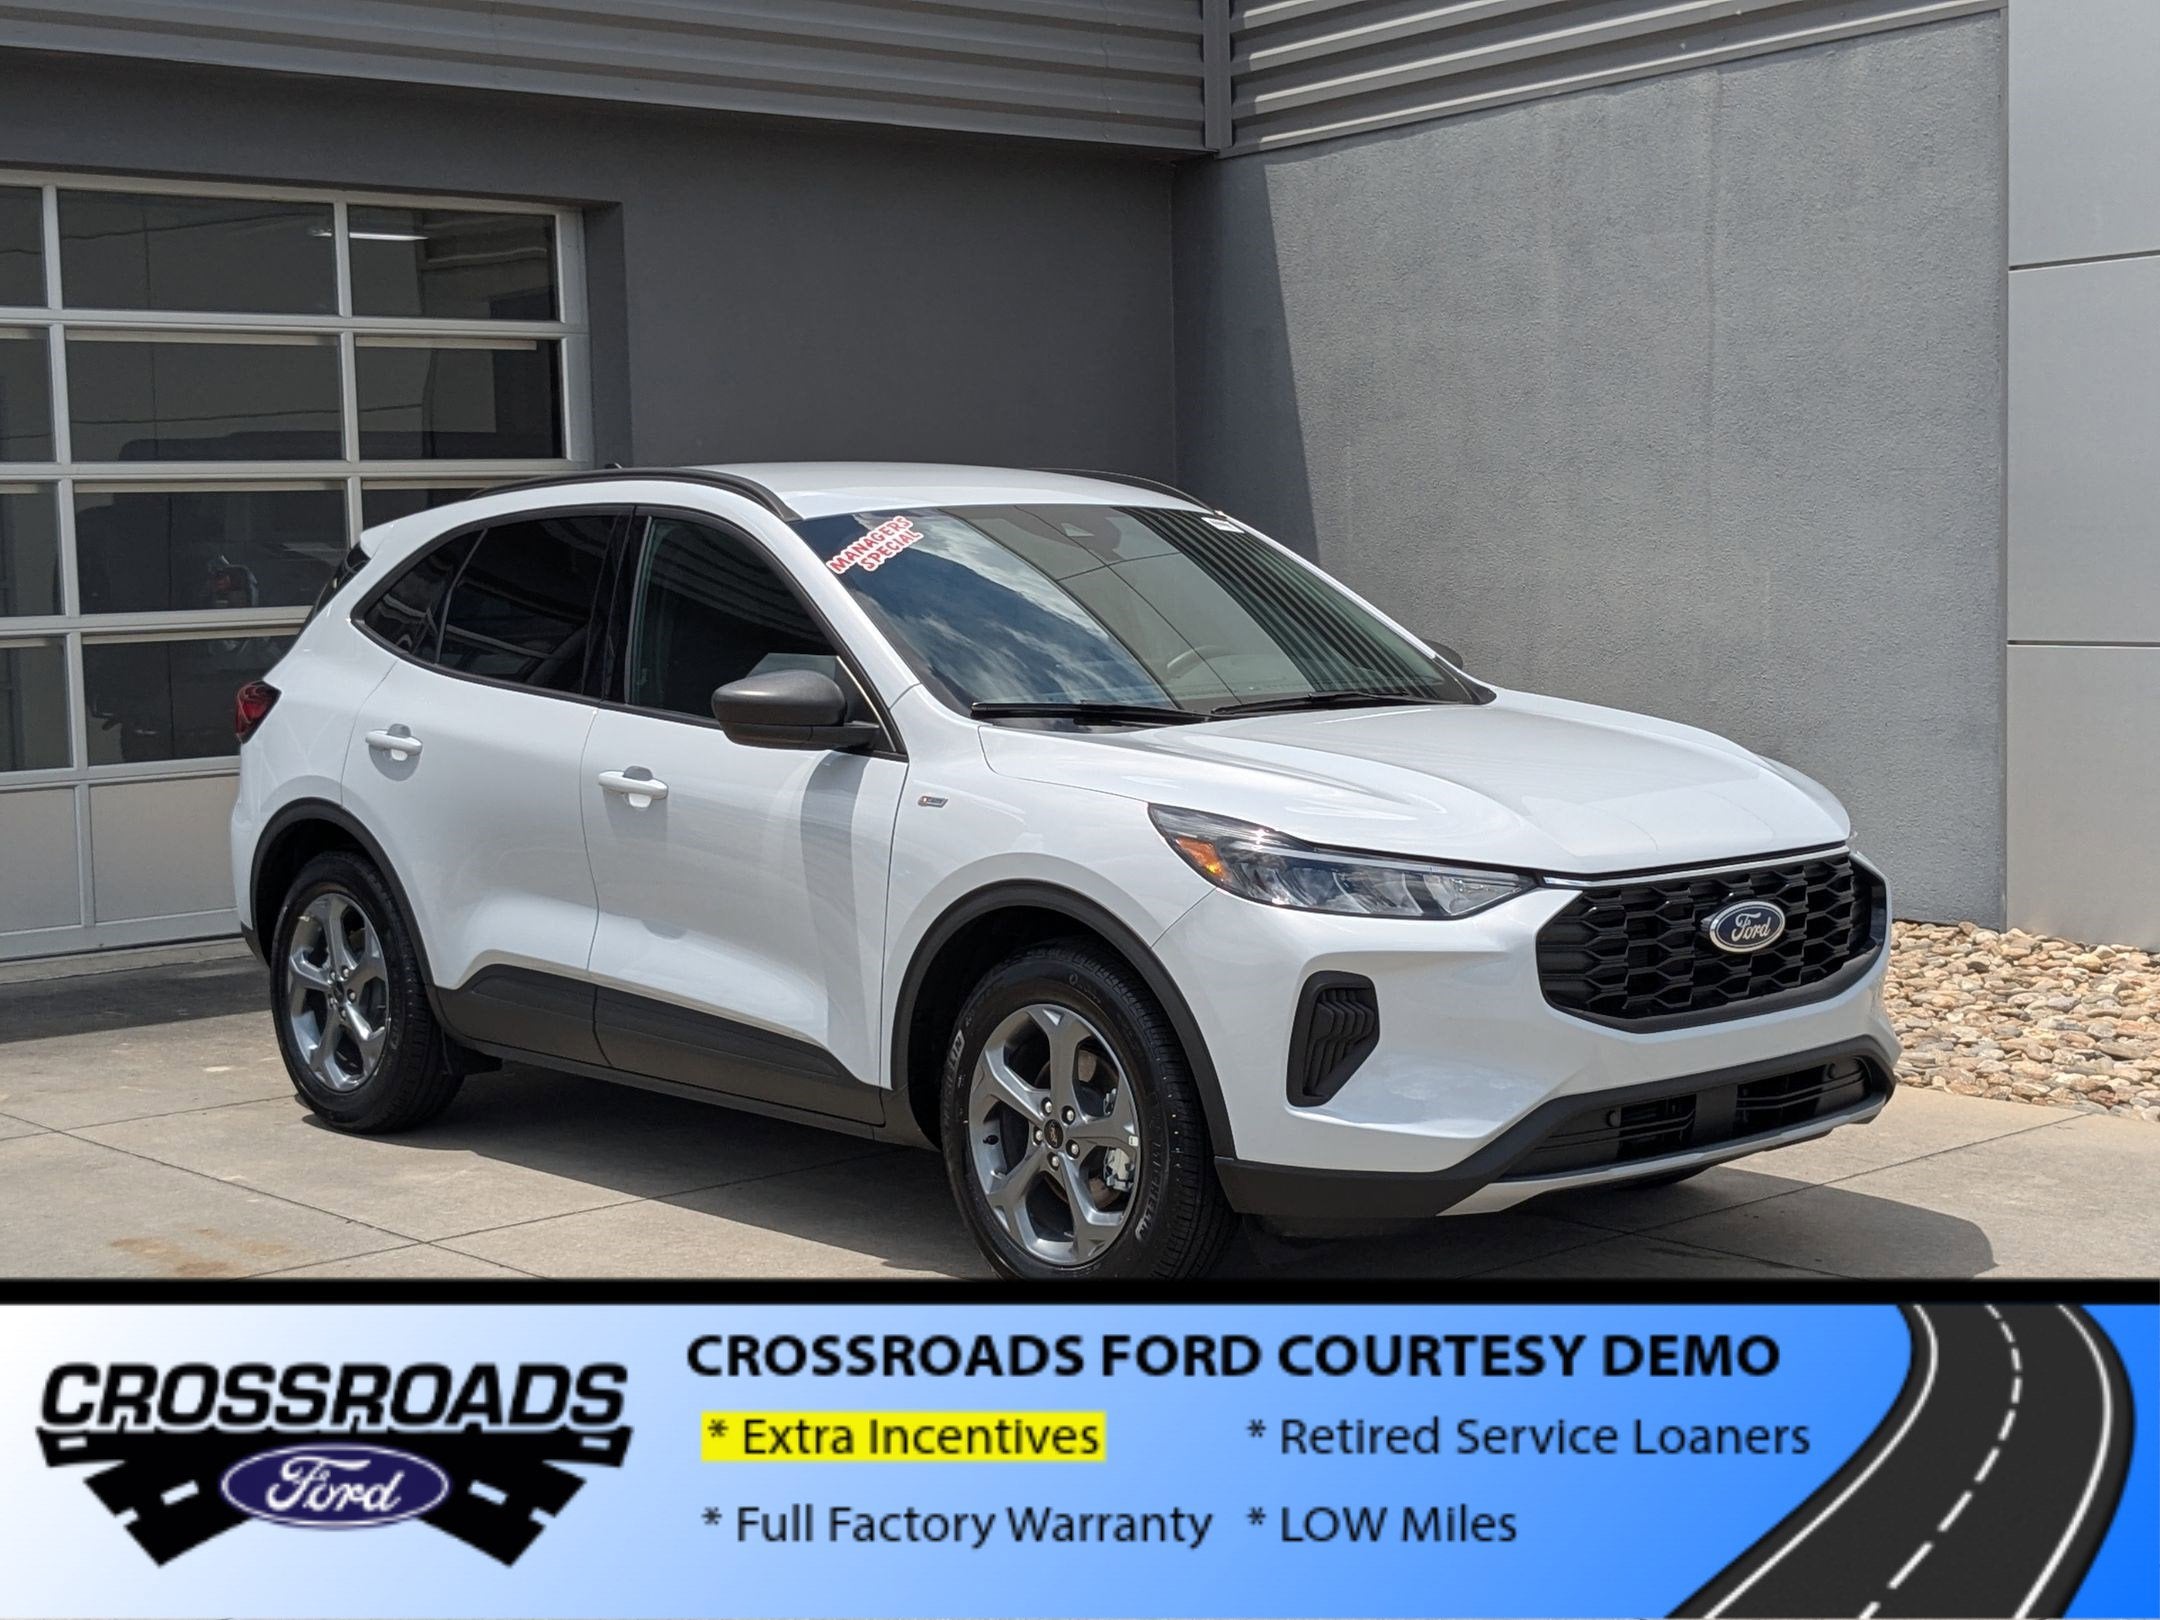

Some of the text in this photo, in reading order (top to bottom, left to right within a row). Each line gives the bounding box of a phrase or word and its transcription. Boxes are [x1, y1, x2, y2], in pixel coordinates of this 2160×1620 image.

[829, 517, 911, 572] MANAGERS
[860, 529, 921, 570] SPECIAL
[1731, 912, 1771, 942] Ford
